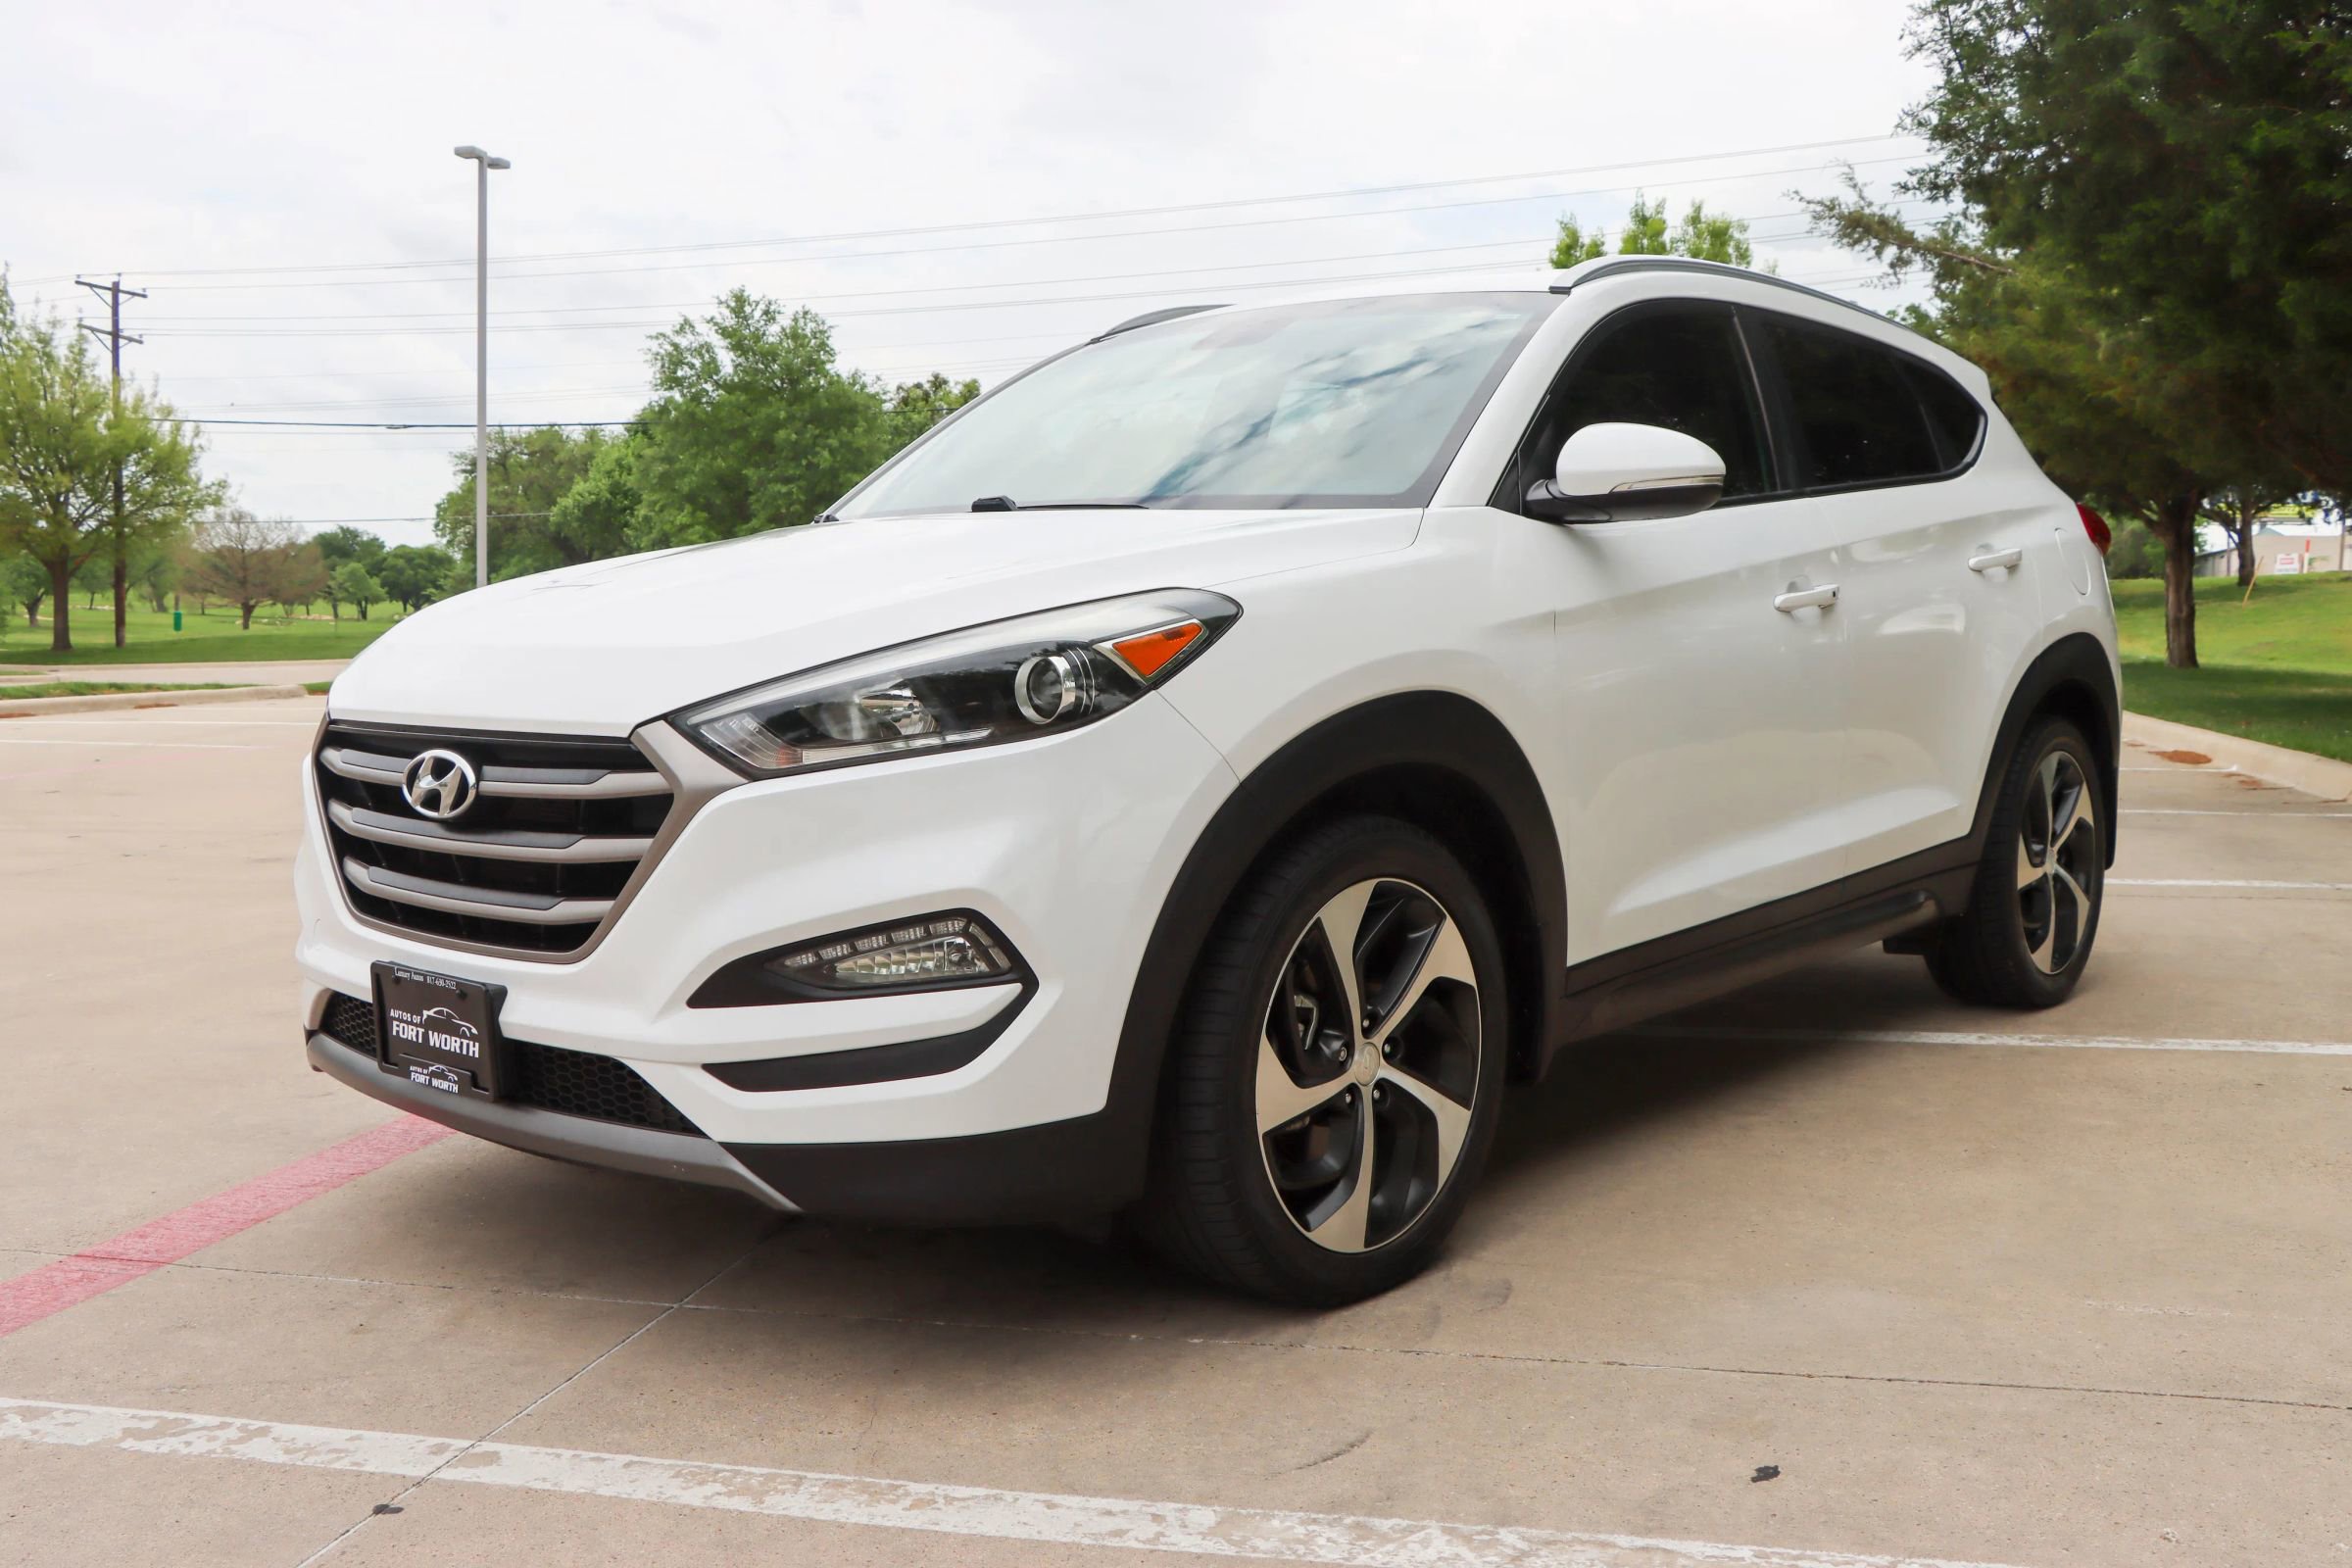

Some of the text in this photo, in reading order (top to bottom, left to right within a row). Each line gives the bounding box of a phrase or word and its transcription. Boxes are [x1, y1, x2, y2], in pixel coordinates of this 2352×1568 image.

[389, 1008, 421, 1024] AUTOS OF
[392, 1020, 479, 1058] FORT WORTH
[411, 1071, 459, 1094] FORT WORTH
